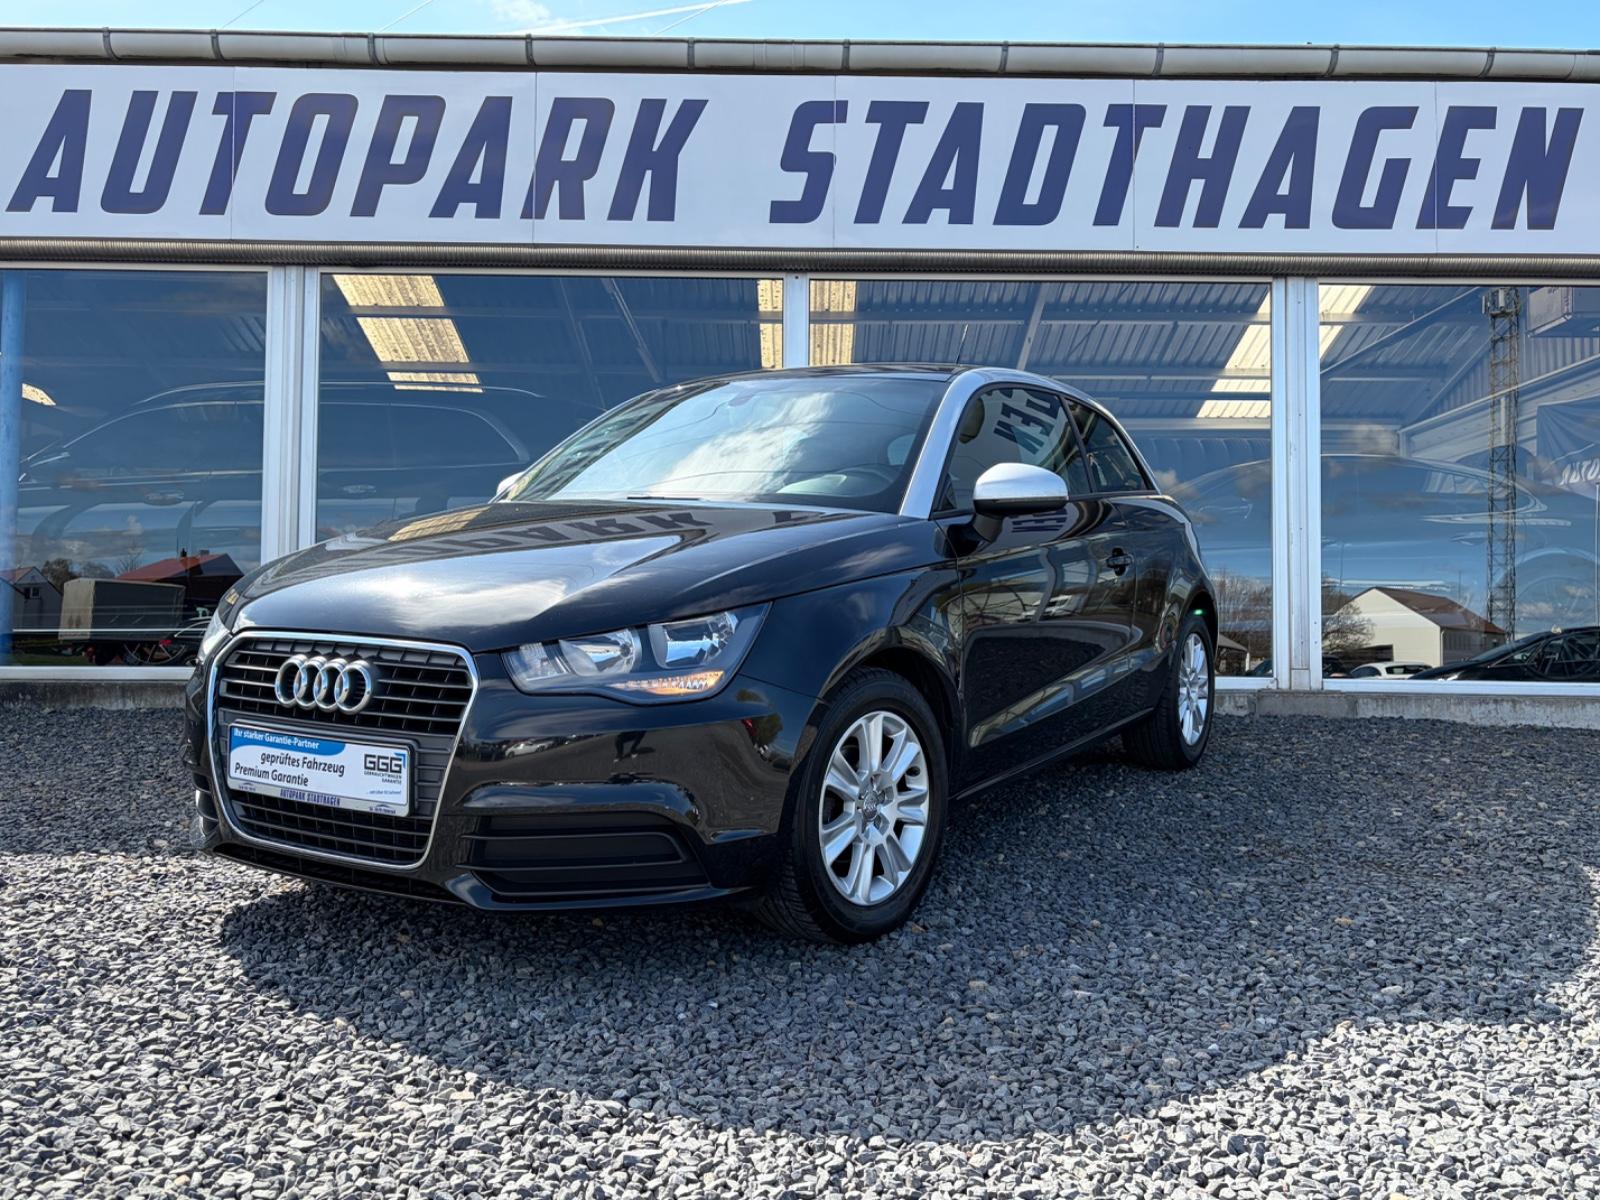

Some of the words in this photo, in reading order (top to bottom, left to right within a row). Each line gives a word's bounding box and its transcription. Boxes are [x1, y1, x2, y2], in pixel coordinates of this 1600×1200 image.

[5, 89, 709, 222] AUTOPARK
[769, 99, 1584, 230] STADTHAGEN
[1559, 457, 1600, 486] AUTO
[233, 728, 243, 737] Ihr
[243, 730, 264, 741] starker
[265, 733, 320, 749] Garantie-Partner
[234, 762, 270, 780] Premium
[271, 769, 309, 786] Garantie
[260, 752, 300, 768] geprüftes
[301, 756, 345, 777] Fahrzeug
[363, 753, 402, 774] GGG
[280, 787, 306, 801] AUTOPARK
[307, 791, 341, 807] STADTHAGEN
